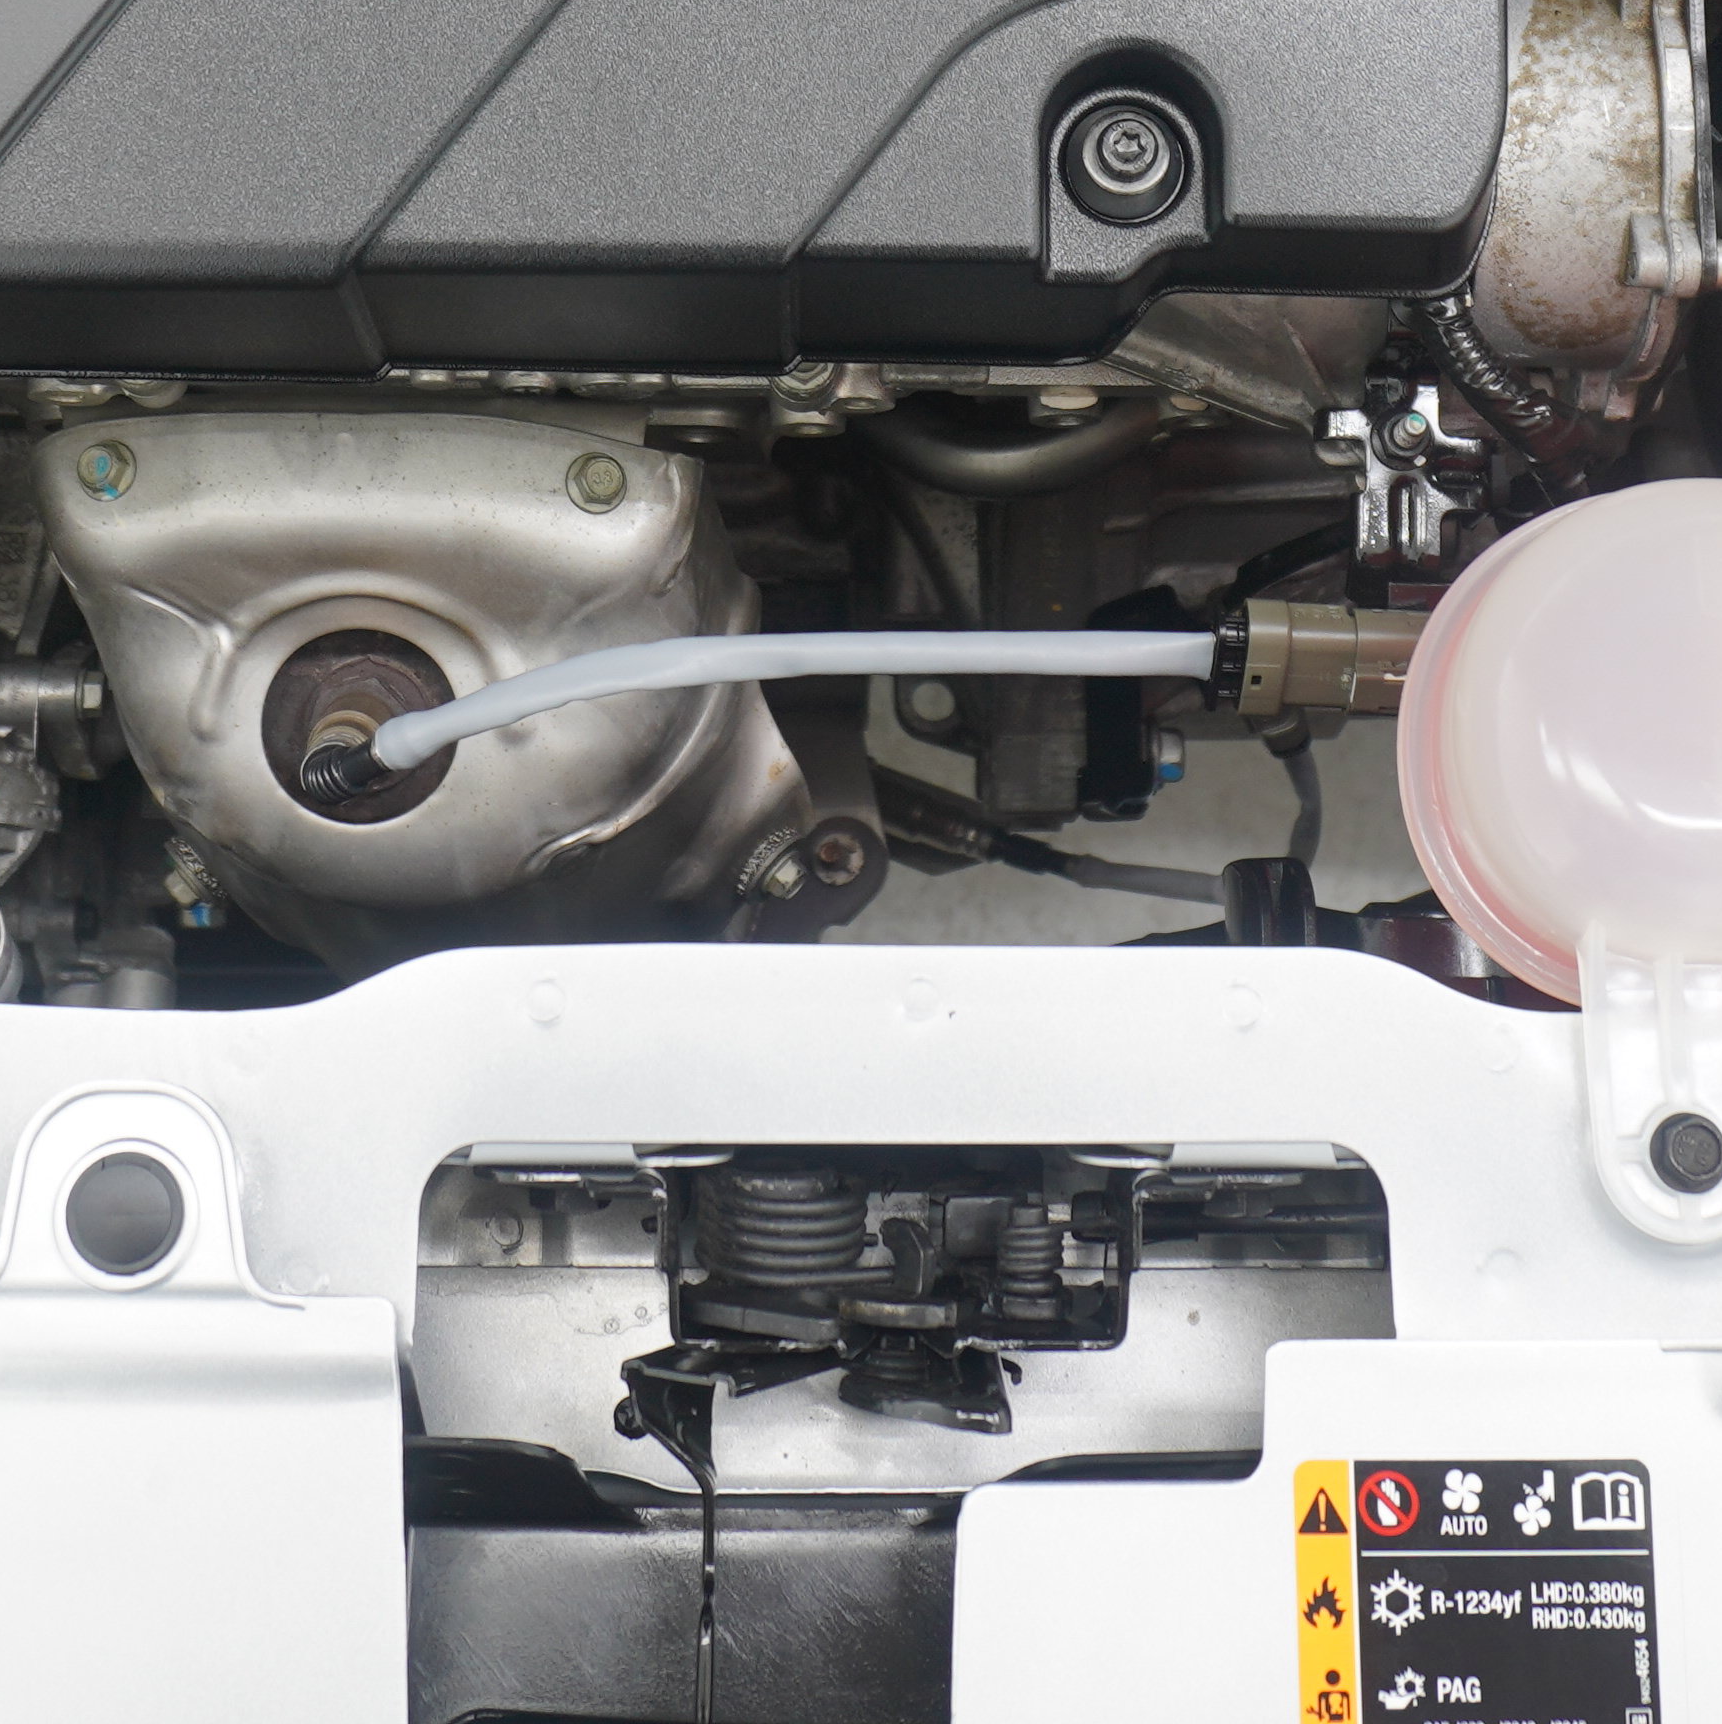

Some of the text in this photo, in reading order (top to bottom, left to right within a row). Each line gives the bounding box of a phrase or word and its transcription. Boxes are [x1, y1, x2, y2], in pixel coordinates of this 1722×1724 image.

[1440, 1515, 1488, 1536] AUTO
[1431, 1582, 1645, 1618] R-1234yf LHD:0.380kg
[1532, 1607, 1646, 1633] RHD:0.430kg
[1437, 1677, 1482, 1704] PAG
